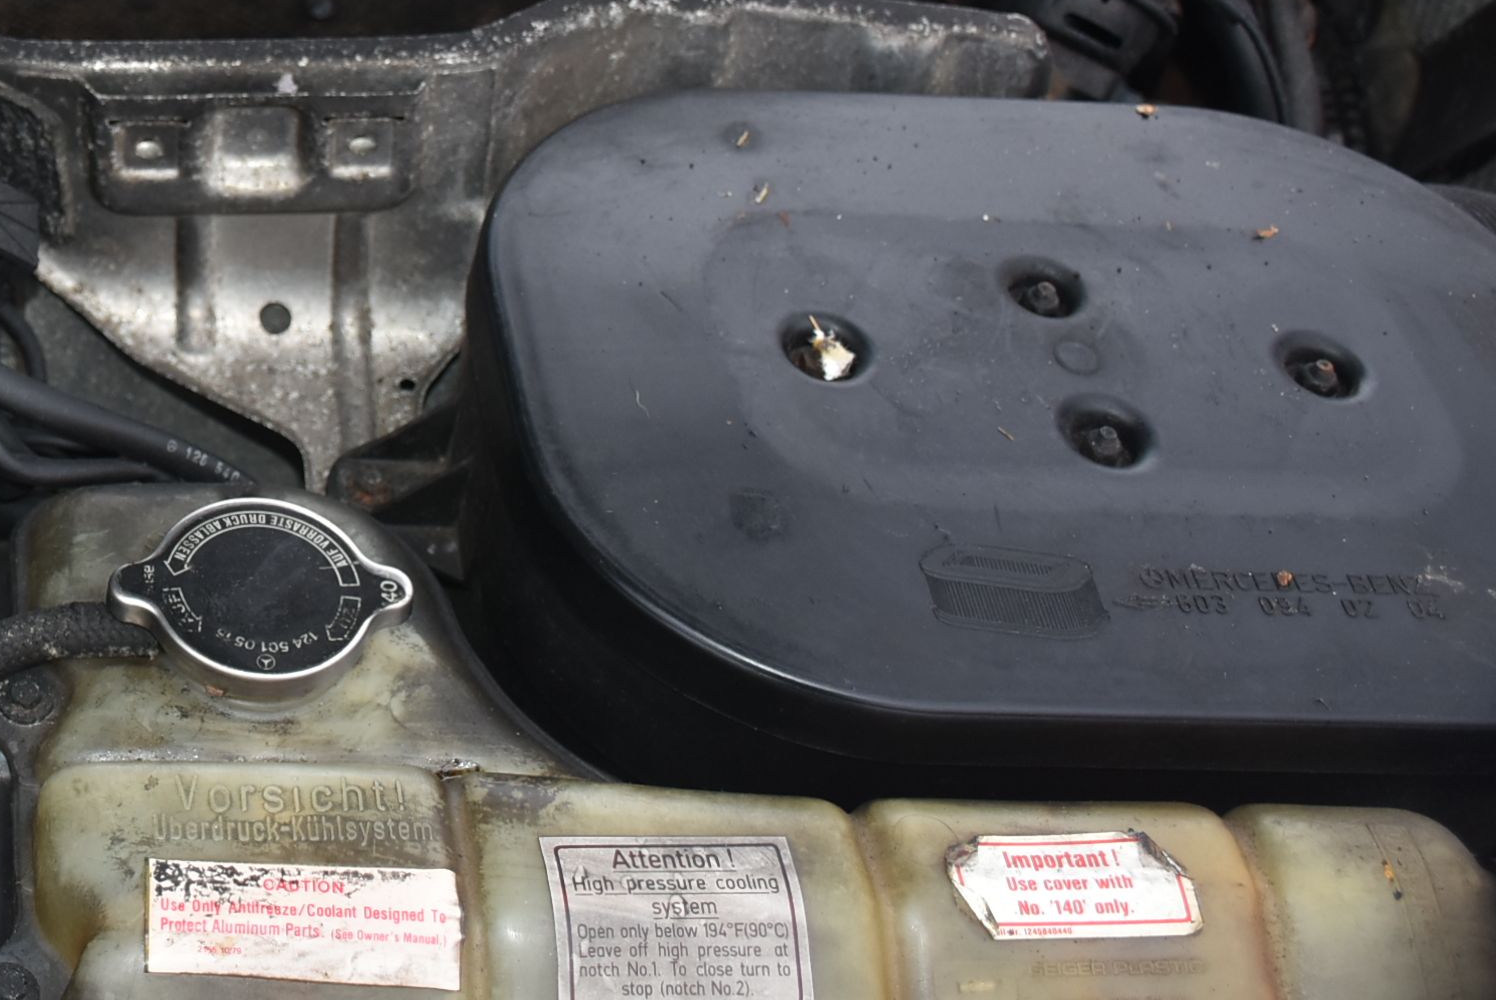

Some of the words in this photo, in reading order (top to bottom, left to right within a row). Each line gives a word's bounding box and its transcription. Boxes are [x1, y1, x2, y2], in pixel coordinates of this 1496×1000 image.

[222, 513, 266, 527] DRUCK
[174, 520, 222, 561] ABLASSEN
[271, 515, 330, 549] VORRASTE
[326, 548, 348, 567] AUF
[380, 580, 398, 607] 40
[234, 636, 256, 650] 05
[261, 641, 289, 653] 501
[292, 631, 318, 649] 124
[174, 774, 405, 814] Vorsicht!
[612, 848, 721, 870] Attention
[1002, 850, 1109, 872] Important
[263, 878, 345, 894] CAUTION
[572, 875, 615, 894] High
[626, 877, 706, 894] pressure
[716, 874, 779, 893] cooling
[1006, 877, 1038, 892] Use
[1044, 878, 1088, 891] cover
[1095, 875, 1134, 889] with
[160, 898, 185, 912] Use
[192, 899, 221, 915] Only
[229, 900, 356, 918] Antifreeze/Coolant
[364, 906, 425, 924] Designed
[431, 909, 447, 923] To
[652, 899, 717, 919] system
[1017, 900, 1045, 916] No.
[1049, 899, 1088, 916] '140'
[1094, 898, 1135, 917] only.
[160, 917, 207, 933] Protect
[212, 919, 280, 935] Aluminum
[331, 929, 353, 942] (See
[357, 930, 399, 943] Owner's
[577, 923, 615, 941] Open
[620, 923, 649, 943] only
[654, 922, 698, 939] below
[578, 942, 622, 958] Leave
[629, 941, 649, 957] off
[657, 941, 689, 961] high
[697, 944, 762, 961] pressure
[774, 943, 789, 958] at
[579, 961, 620, 977] notch
[627, 961, 661, 977] No.1.
[670, 961, 687, 977] To
[695, 961, 734, 977] close
[740, 962, 771, 977] turn
[777, 962, 791, 977] to
[621, 982, 653, 999] stop
[659, 980, 705, 998] (notch
[711, 980, 755, 998] No.2).
